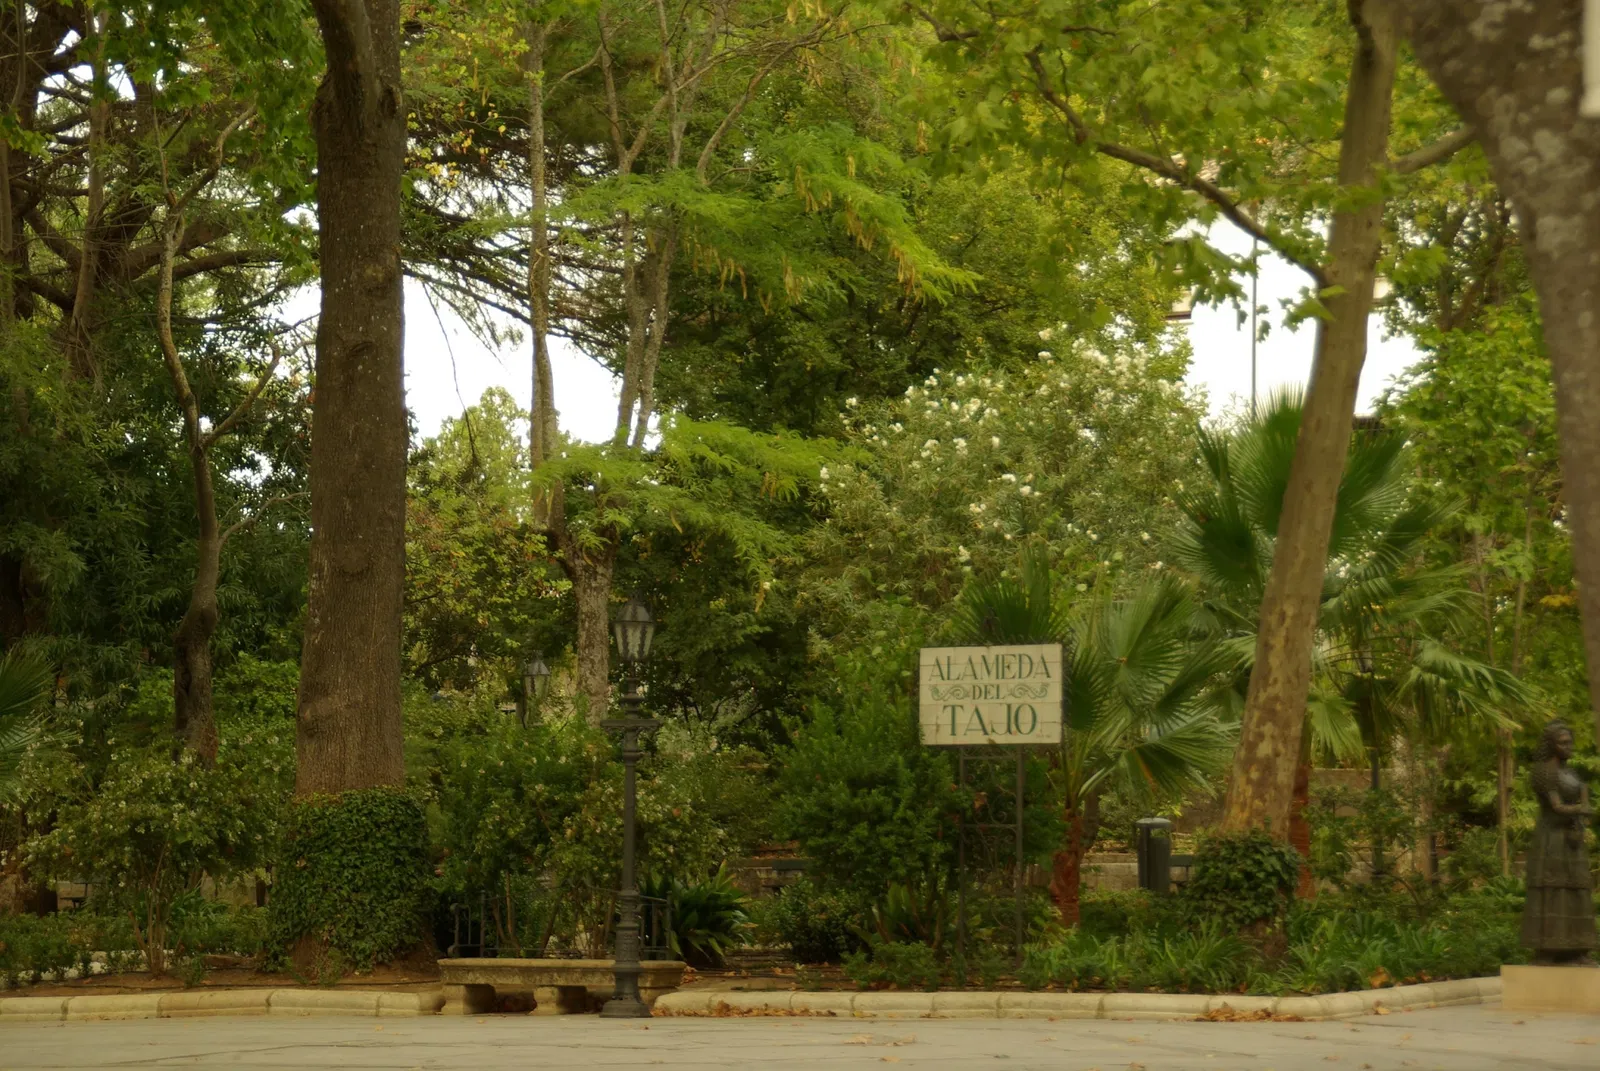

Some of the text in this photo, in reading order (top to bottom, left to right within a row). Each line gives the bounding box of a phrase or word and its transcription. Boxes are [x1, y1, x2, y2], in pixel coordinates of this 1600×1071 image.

[928, 653, 1052, 682] ALAMEDA
[972, 684, 1006, 700] DEL
[942, 703, 1037, 736] TAJO
